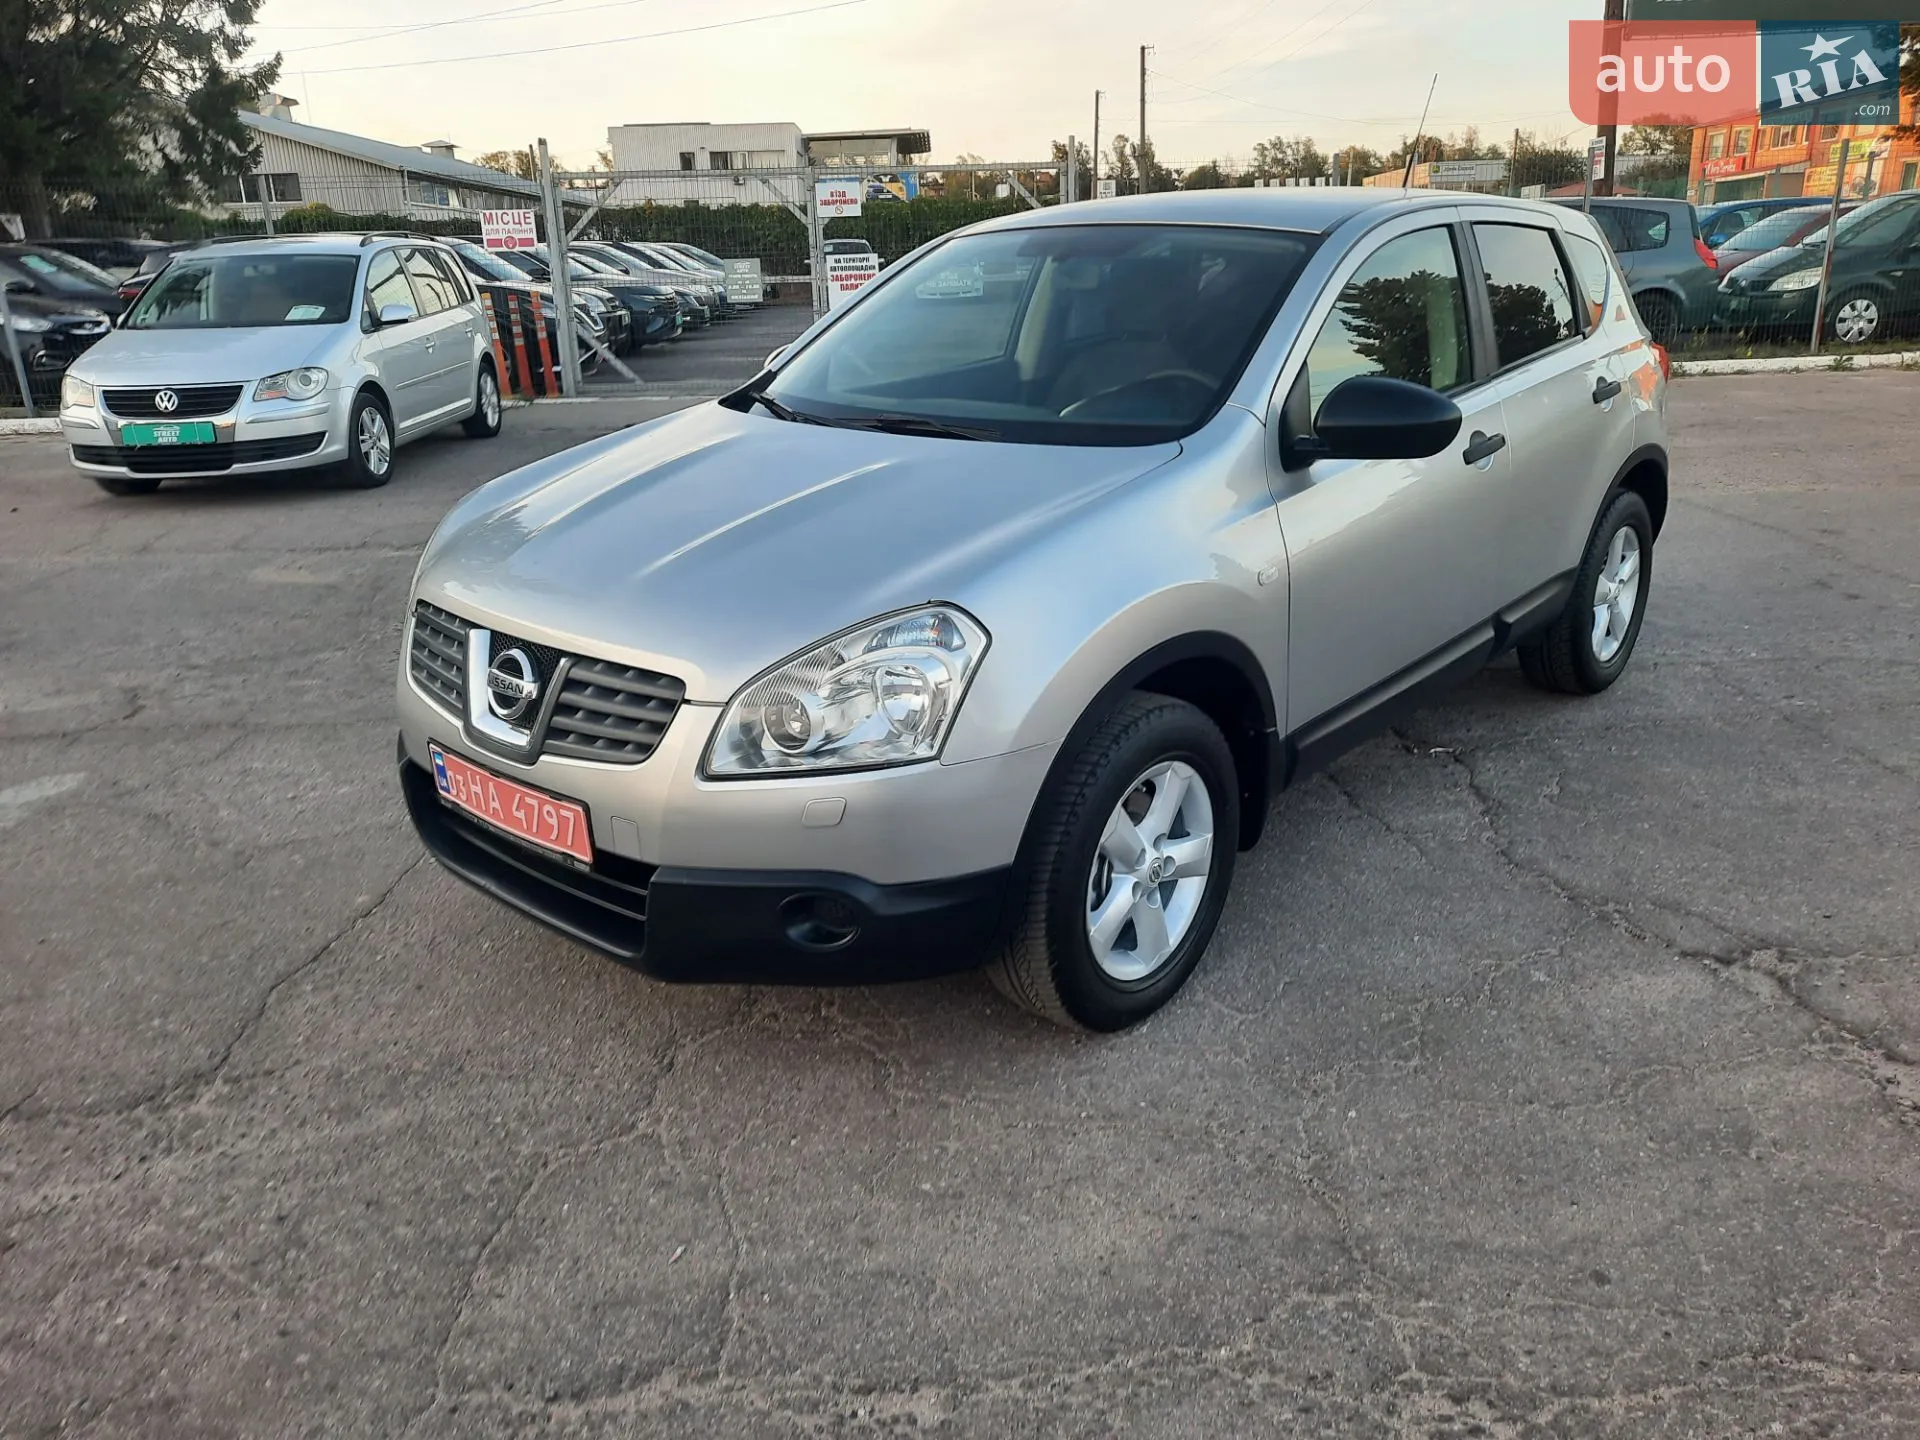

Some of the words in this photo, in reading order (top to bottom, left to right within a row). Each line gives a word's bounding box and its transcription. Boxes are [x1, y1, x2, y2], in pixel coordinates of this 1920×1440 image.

[482, 211, 533, 228] МІСЦЕ
[485, 228, 500, 236] ДЛЯ
[501, 227, 534, 236] ПАЛІННЯ
[153, 430, 180, 438] STREET
[512, 793, 575, 847] 4797
